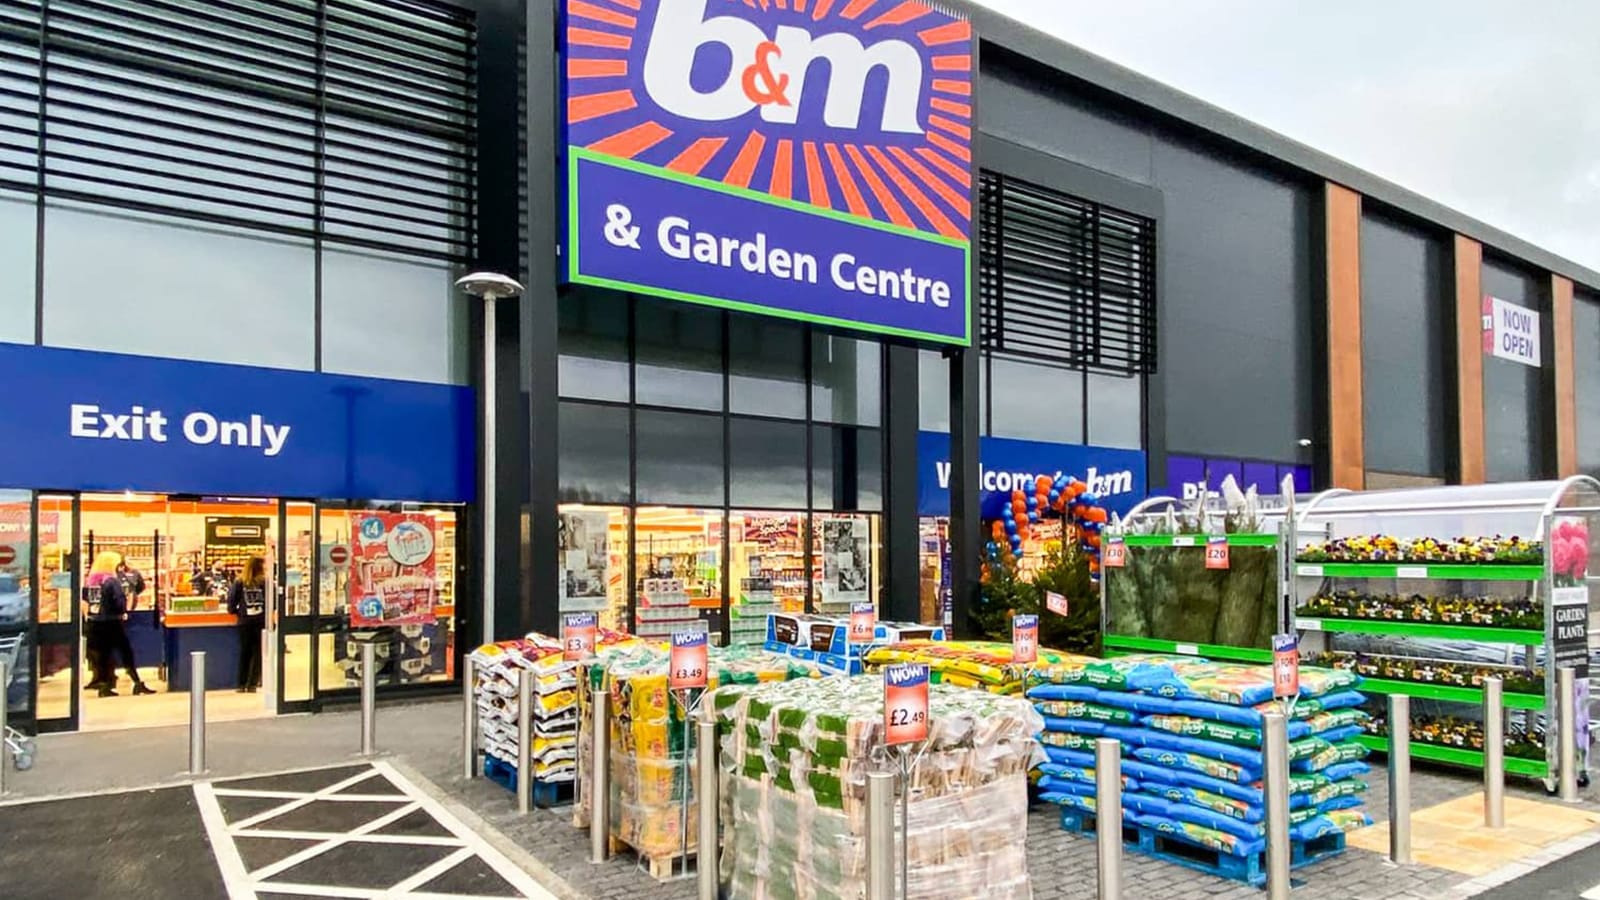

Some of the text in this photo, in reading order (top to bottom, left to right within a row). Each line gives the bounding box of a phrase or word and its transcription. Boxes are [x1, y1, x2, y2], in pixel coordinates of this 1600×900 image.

[643, 0, 926, 134] b&m
[603, 203, 951, 308] & Garden Centre
[1503, 307, 1531, 335] NOW
[1502, 332, 1534, 359] OPEN
[70, 404, 291, 456] Exit Only
[936, 462, 1053, 492] Wlcom
[1086, 467, 1132, 499] b&m
[1207, 549, 1226, 559] £20
[567, 614, 593, 627] WOW!
[1556, 608, 1586, 623] GARDEN
[675, 631, 704, 646] WOW!
[1558, 624, 1585, 640] PLANTS
[676, 668, 703, 680] £3.49
[890, 666, 924, 685] WOW!
[890, 708, 925, 727] £2.49
